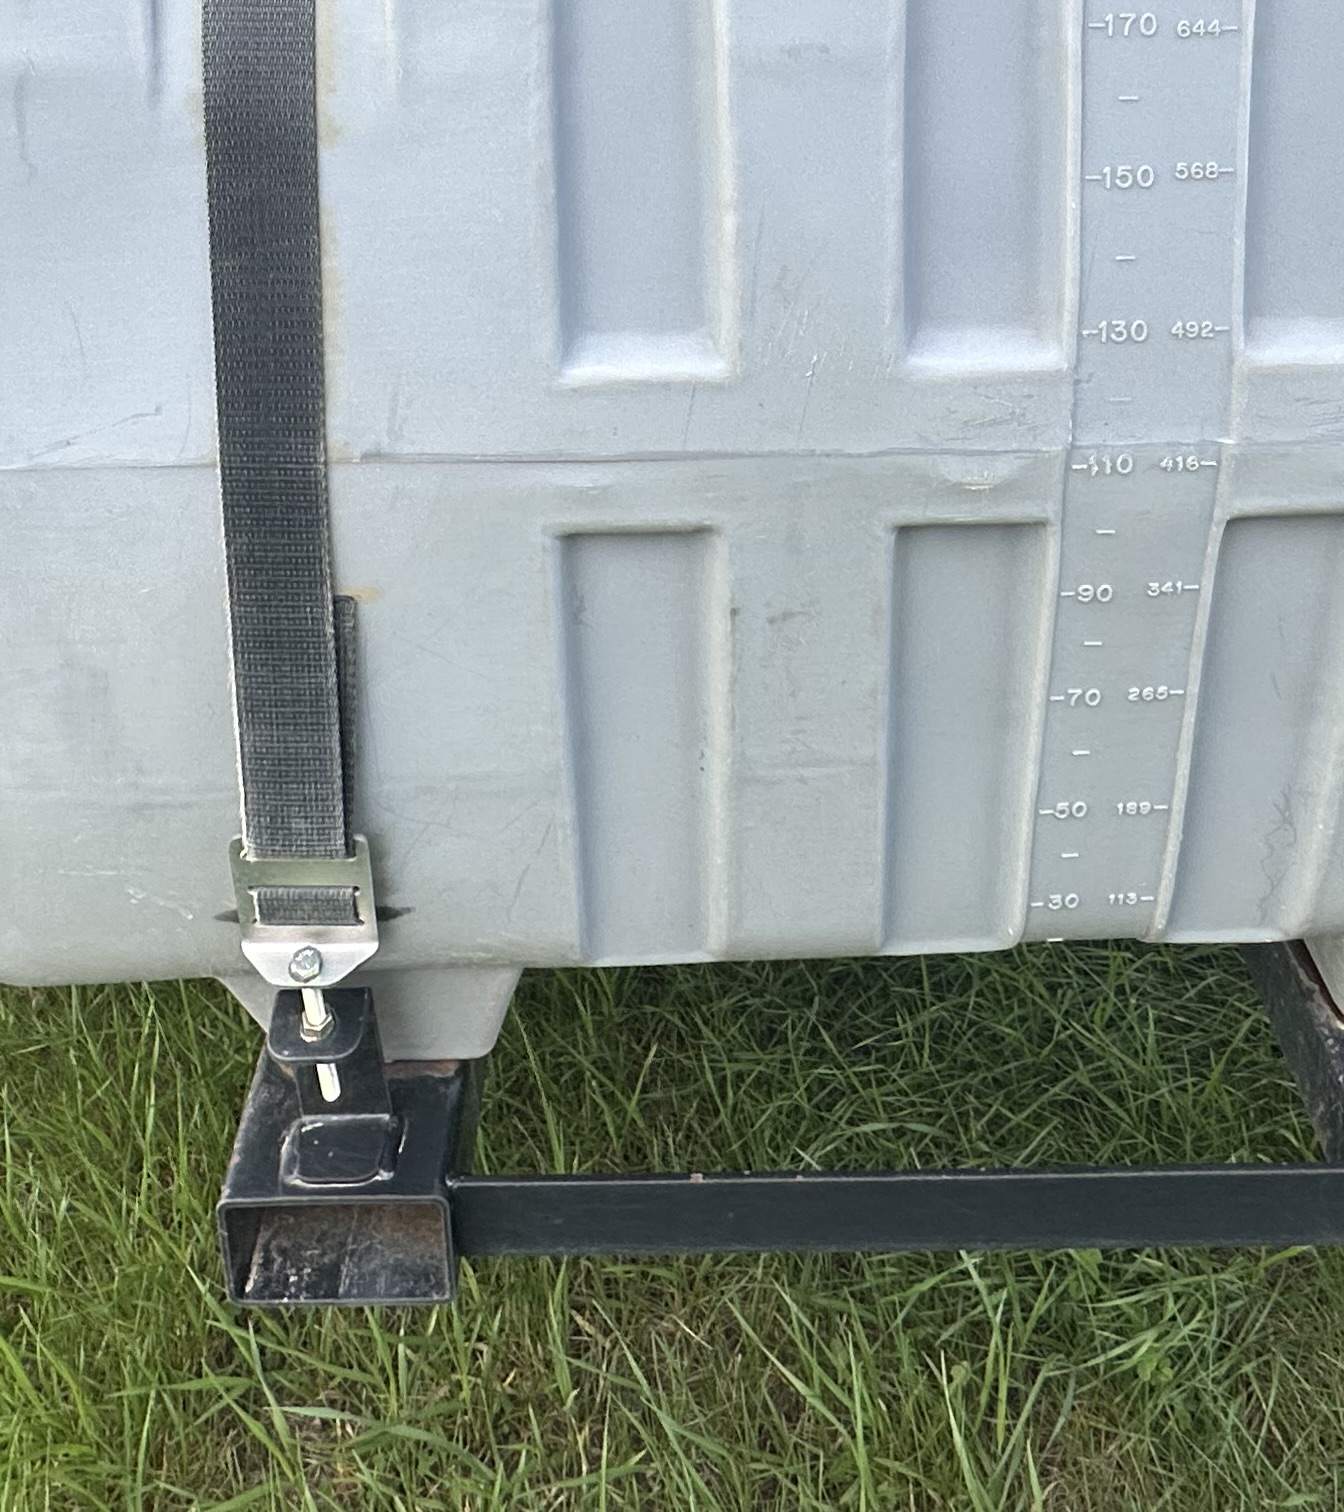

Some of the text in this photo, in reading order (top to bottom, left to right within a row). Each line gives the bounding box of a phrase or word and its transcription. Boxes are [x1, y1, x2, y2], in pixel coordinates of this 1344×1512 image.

[1104, 12, 1222, 38] 170 644
[1101, 161, 1219, 189] 150 568
[1097, 319, 1215, 343] 130 492
[1088, 453, 1200, 476] 110 416
[1076, 580, 1183, 603] 90 341
[1066, 686, 1169, 707] 70 265
[1052, 800, 1152, 820] 50 189
[1047, 892, 1138, 910] 30 113
